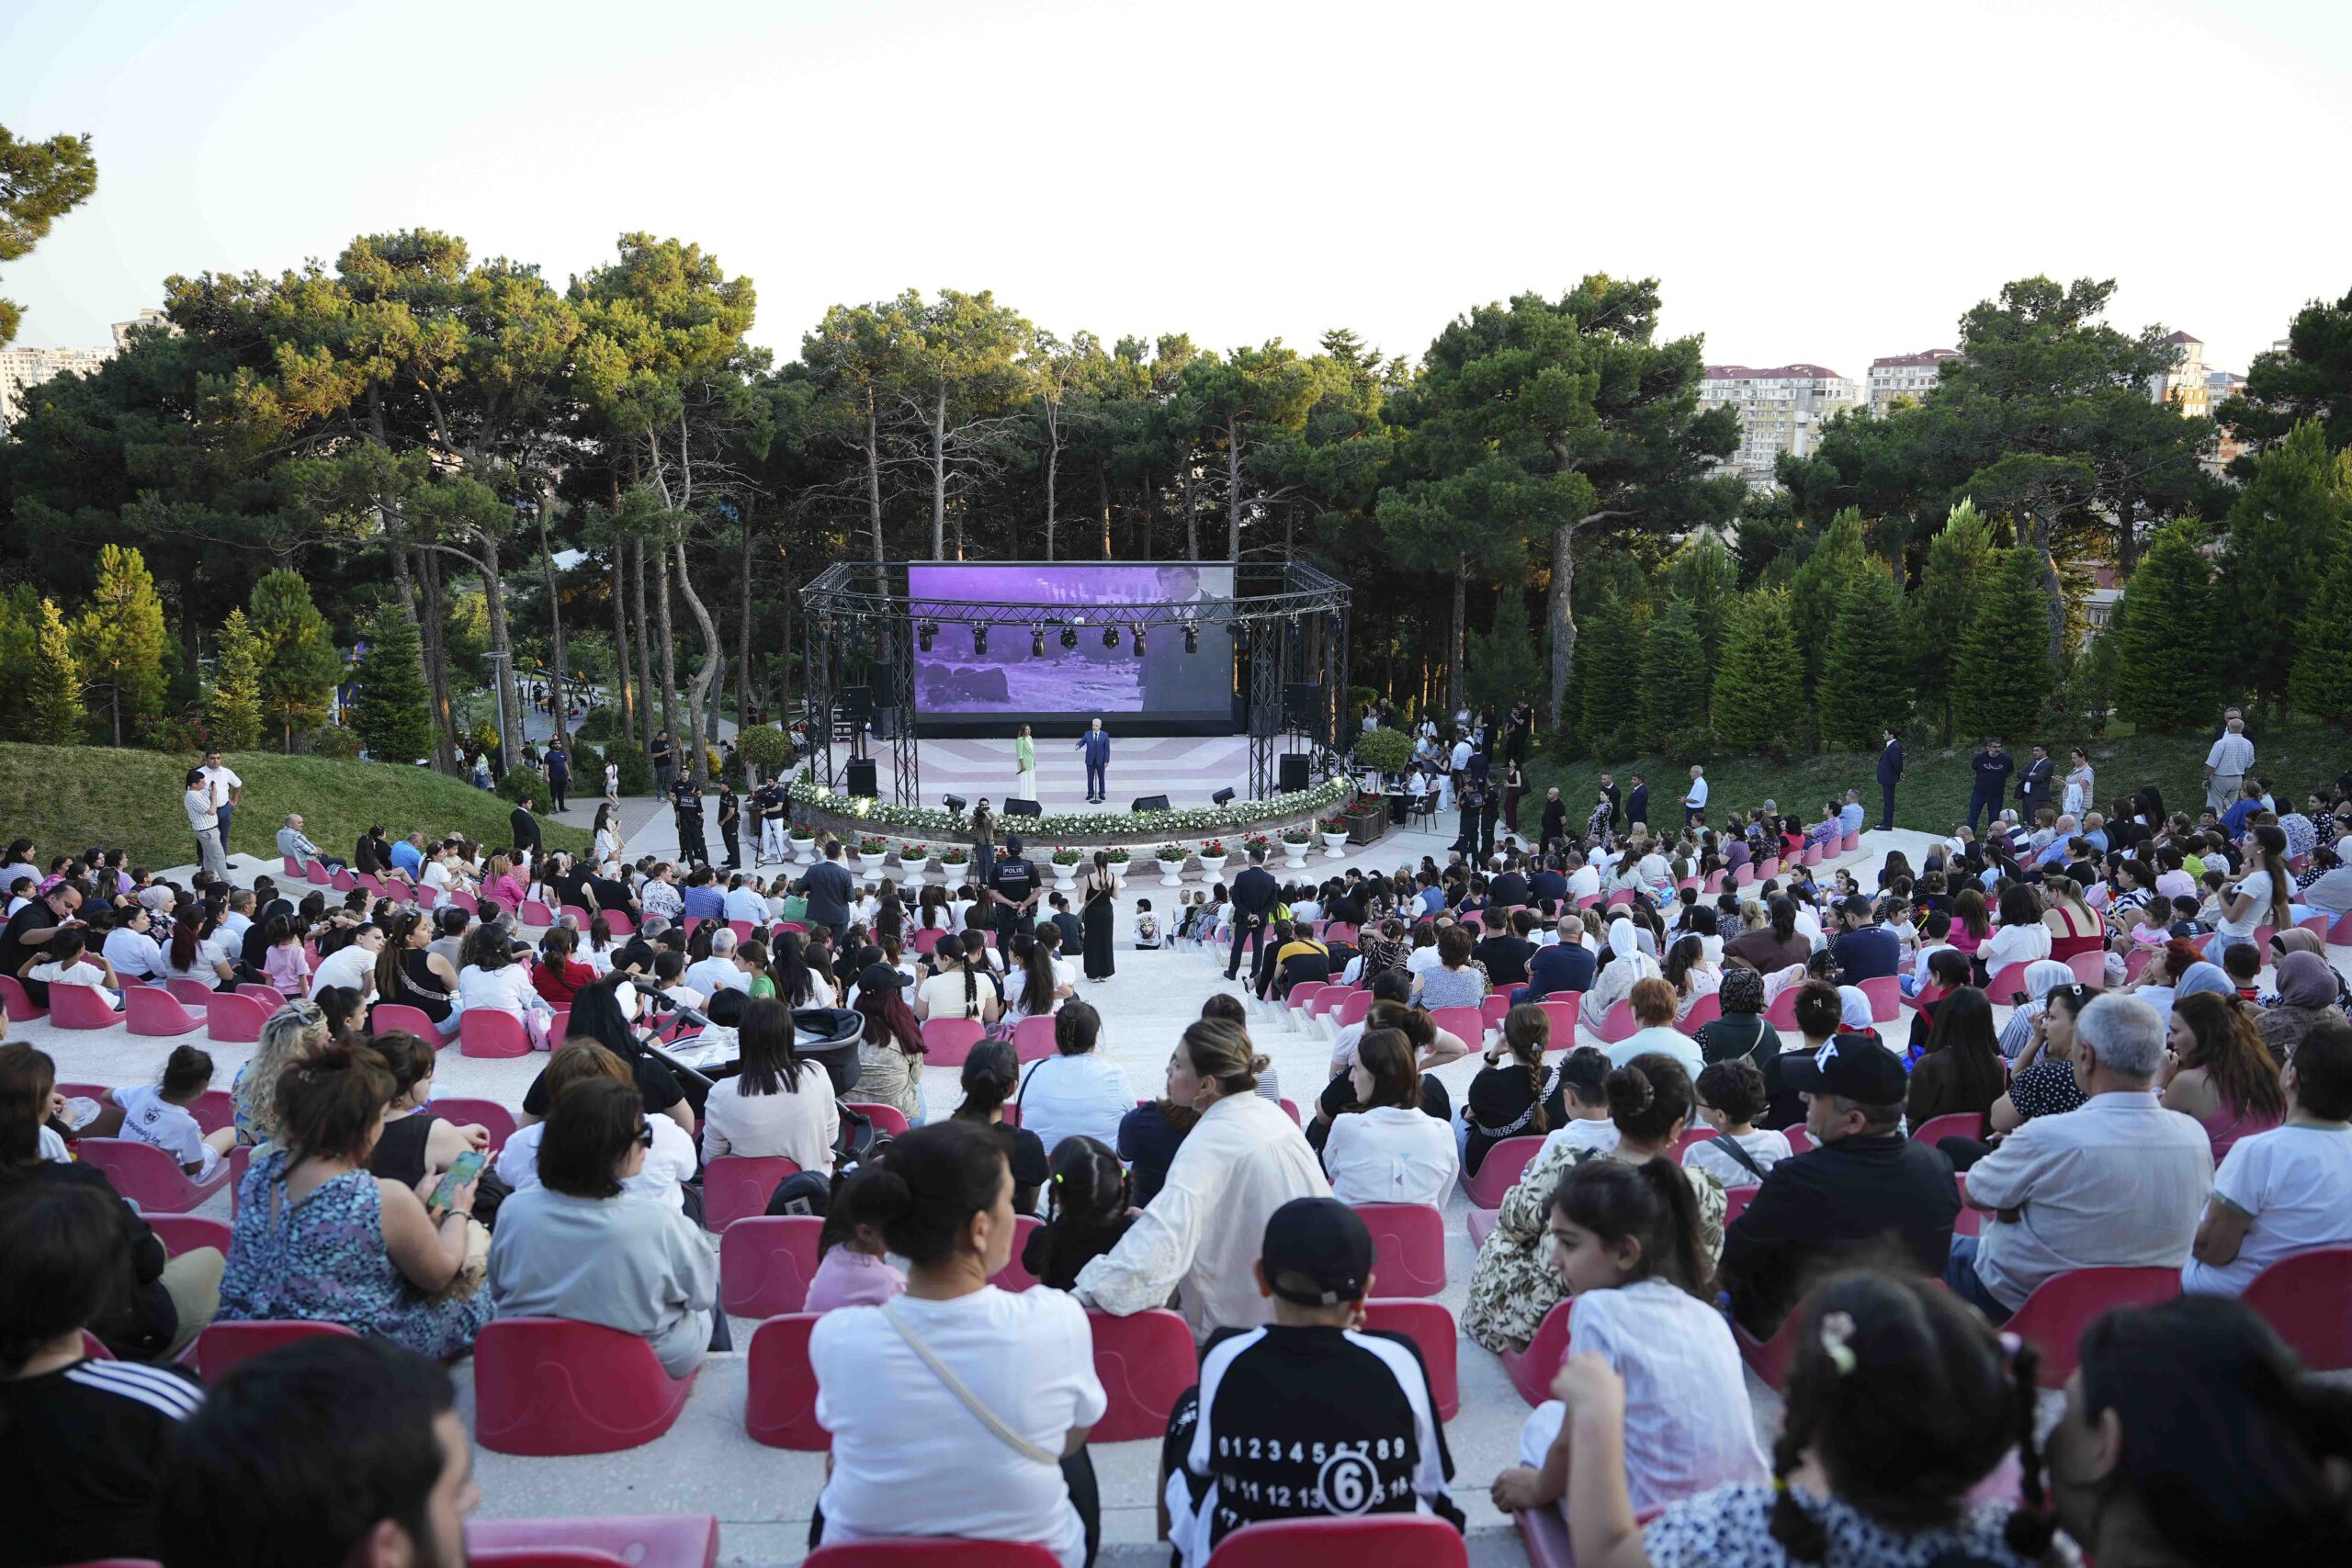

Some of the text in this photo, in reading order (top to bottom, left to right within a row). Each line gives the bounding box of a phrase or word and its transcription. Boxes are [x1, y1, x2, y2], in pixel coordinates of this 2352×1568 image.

[1219, 1436, 1229, 1458] 0
[1232, 1436, 1241, 1458] 1
[1249, 1438, 1261, 1460] 2
[1267, 1439, 1282, 1461] 3
[1289, 1440, 1305, 1463] 4
[1312, 1442, 1327, 1464] 5
[1356, 1440, 1370, 1456] 7
[1376, 1438, 1390, 1461] 8
[1394, 1437, 1406, 1459] 9
[1240, 1480, 1259, 1502] 11
[1266, 1484, 1292, 1507] 12
[1334, 1461, 1364, 1509] 6
